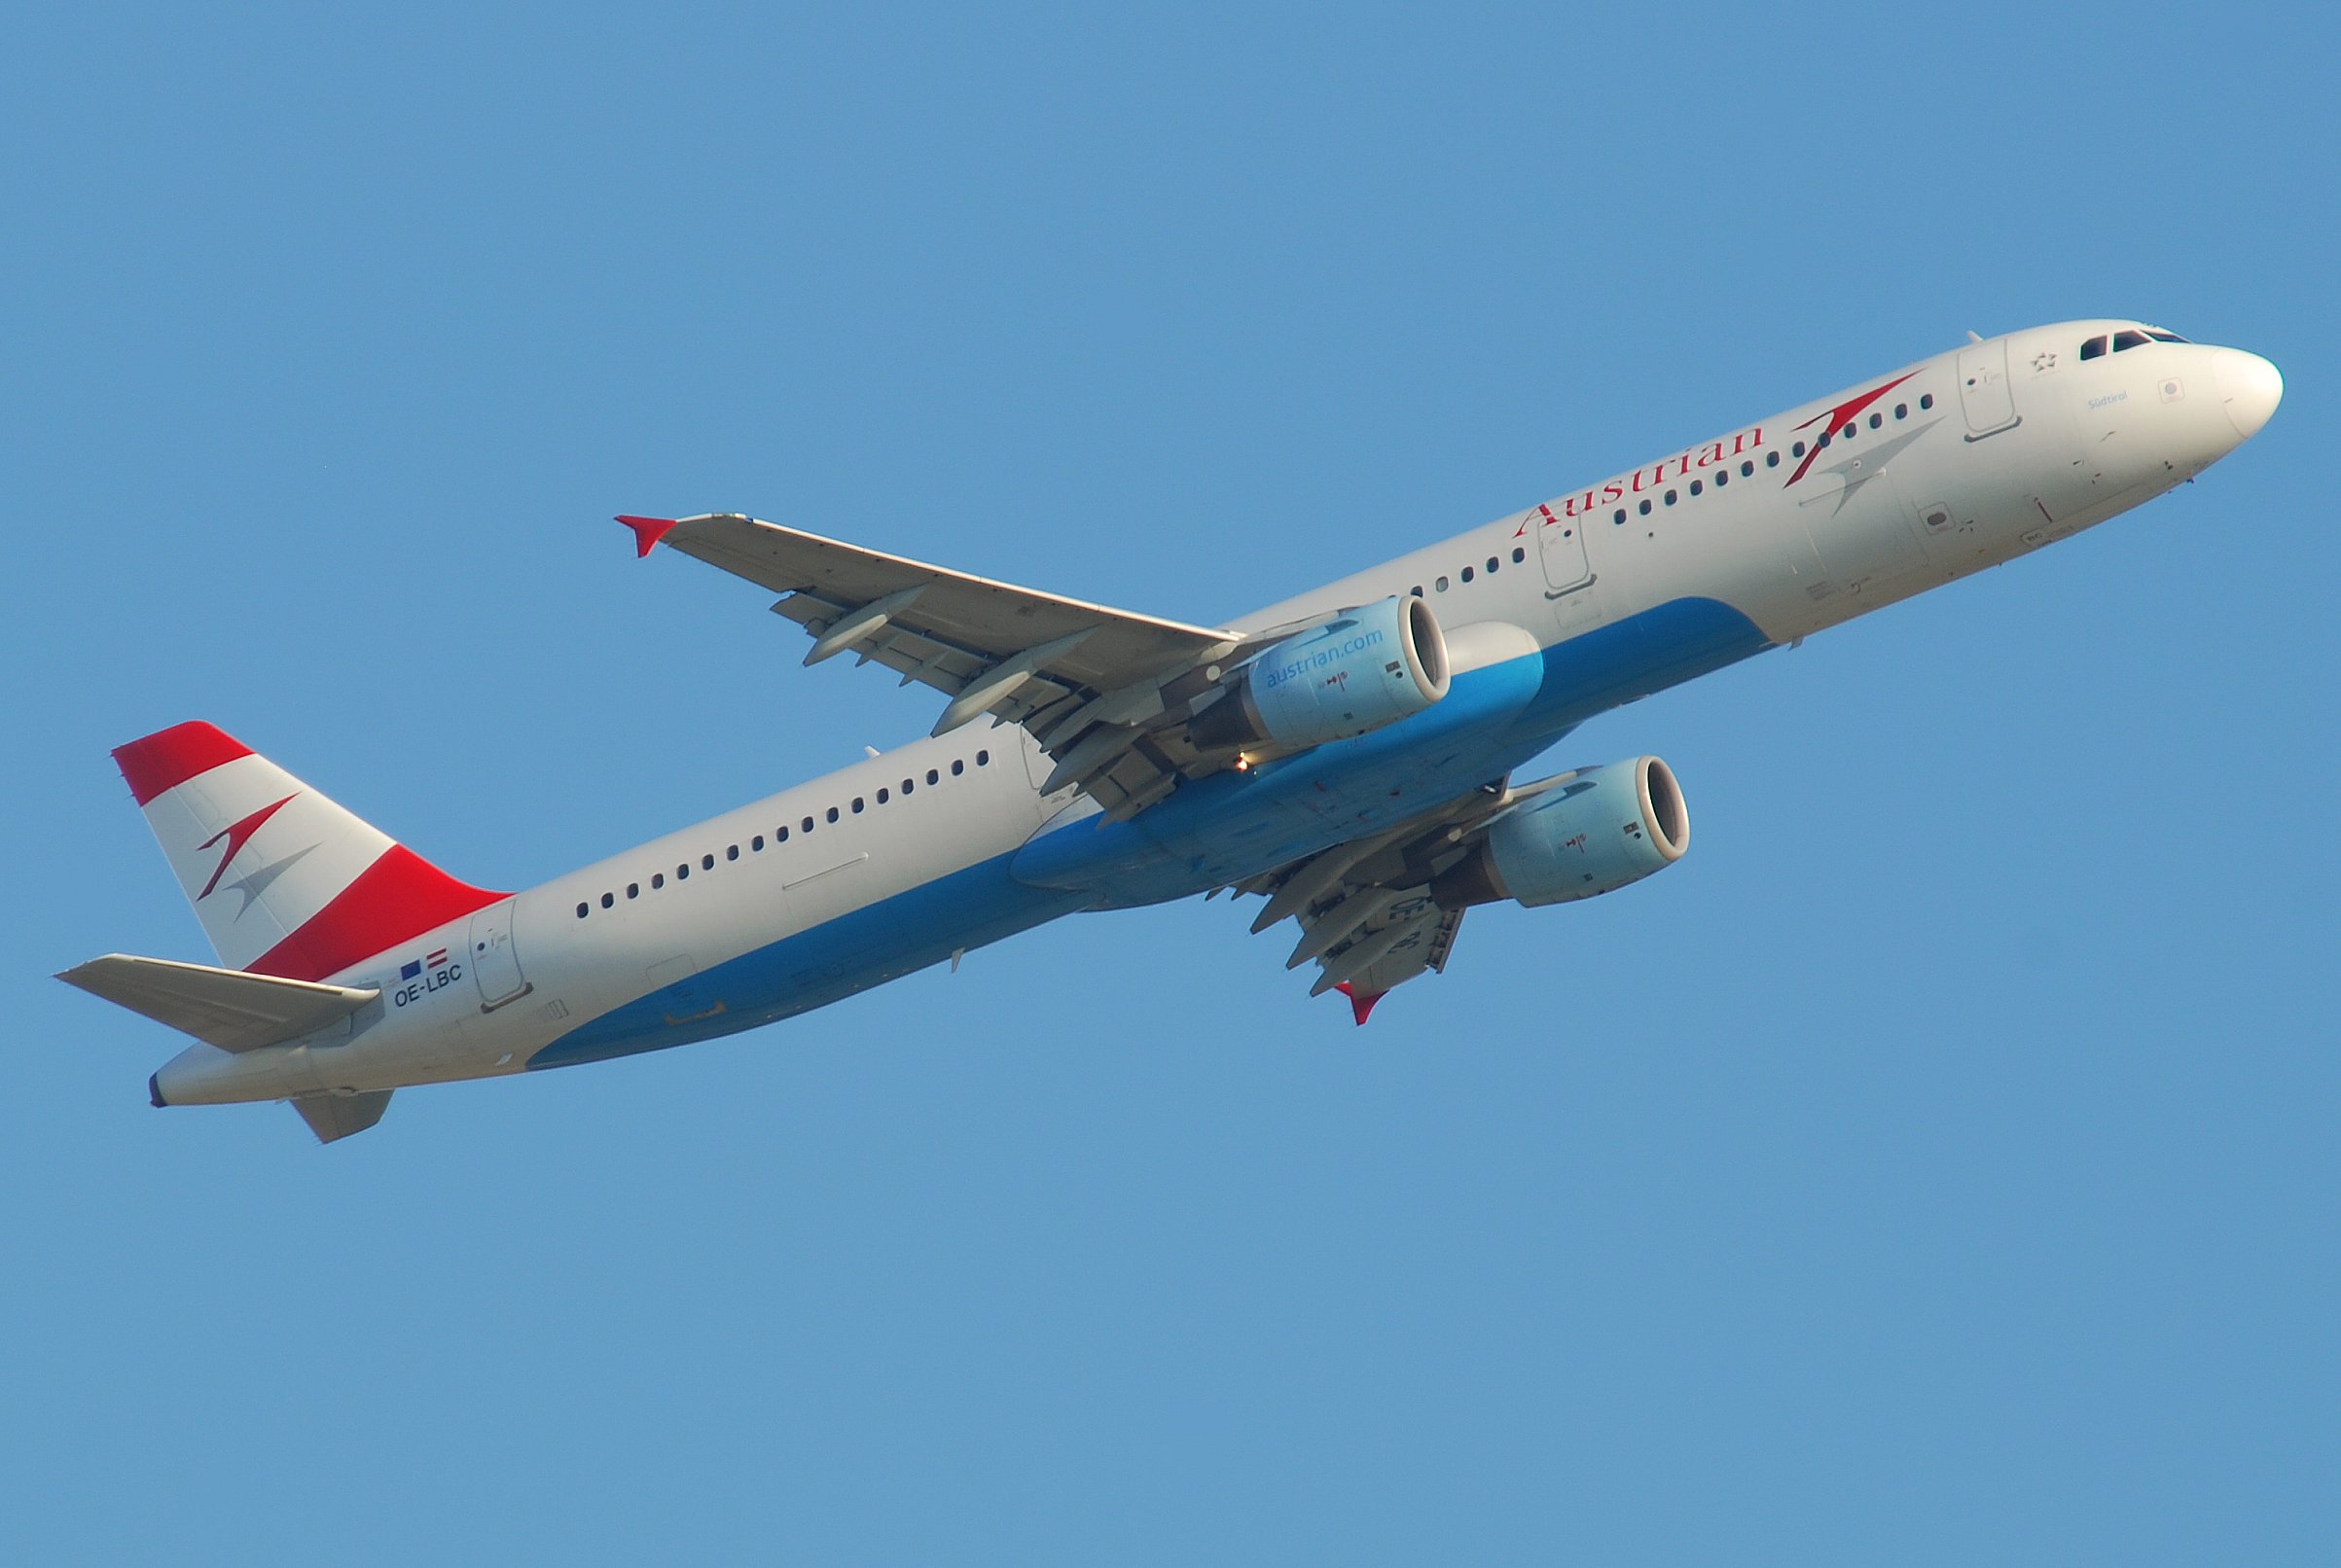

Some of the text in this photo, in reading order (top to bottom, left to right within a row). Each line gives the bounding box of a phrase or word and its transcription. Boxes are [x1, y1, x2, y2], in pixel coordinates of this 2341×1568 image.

[2087, 389, 2128, 410] Südtirol
[1513, 427, 1764, 538] Austrian
[1267, 629, 1384, 688] austrian.com
[395, 965, 461, 1007] OE-LBC
